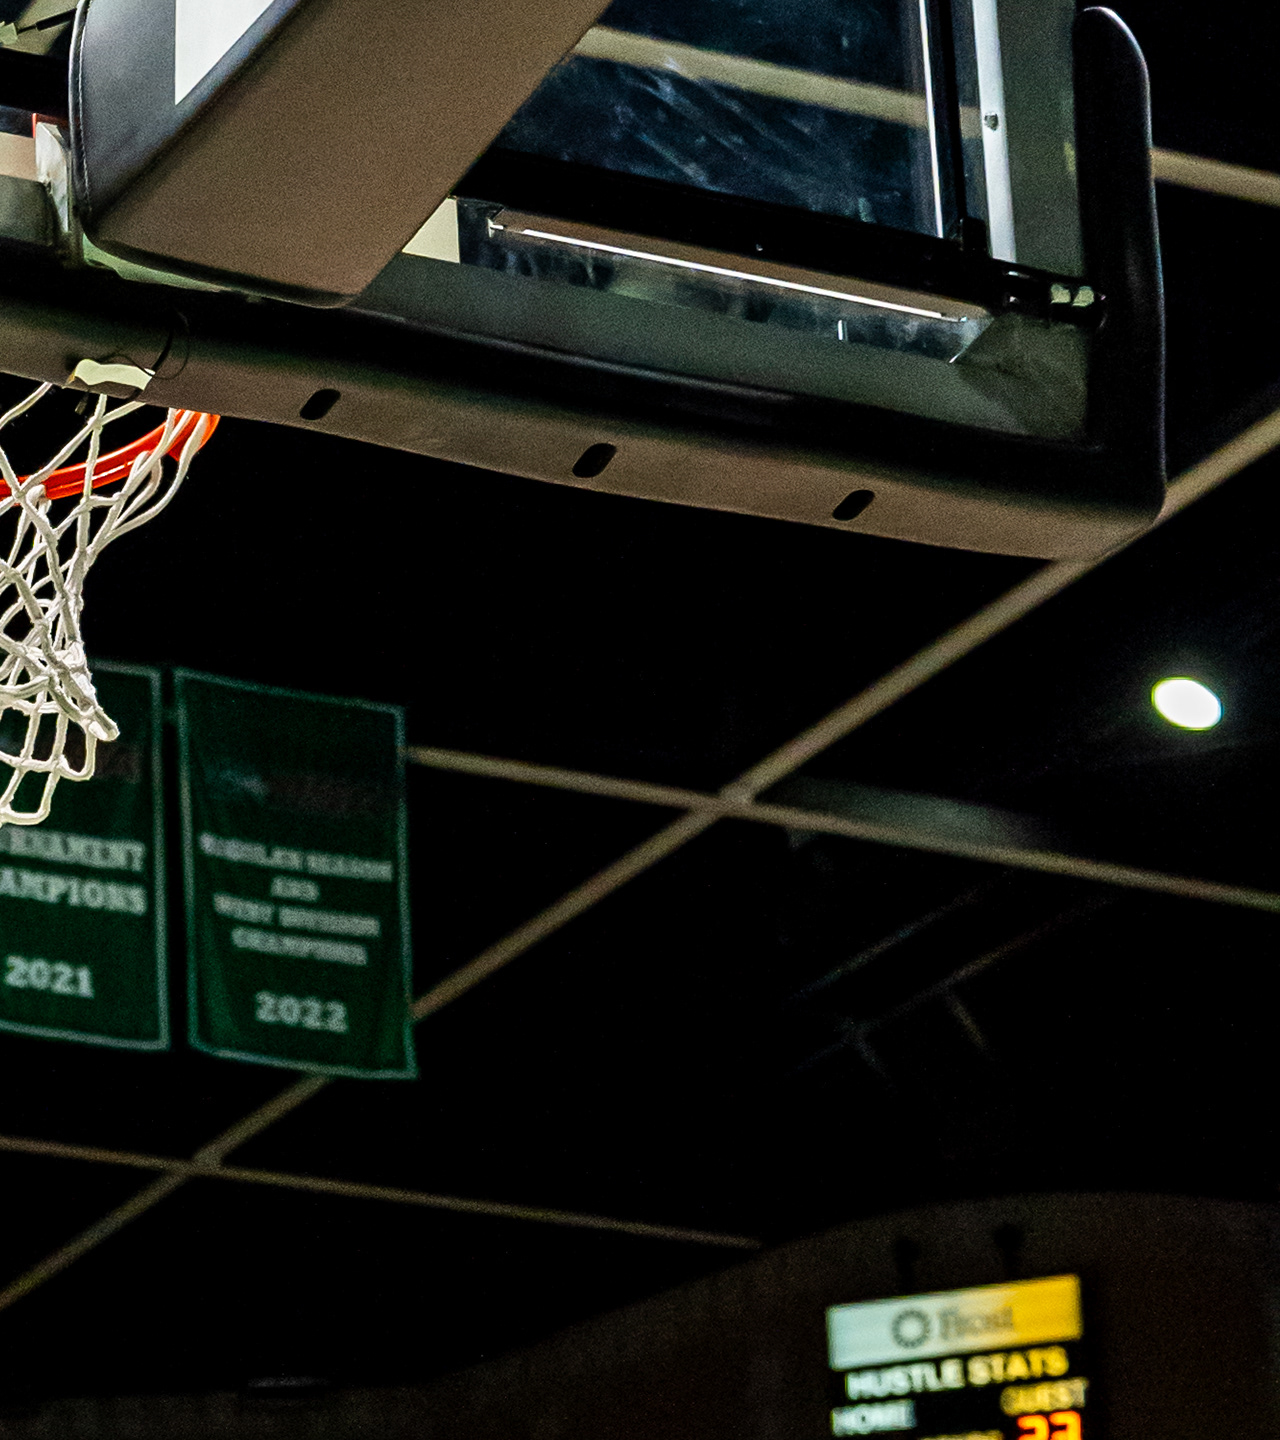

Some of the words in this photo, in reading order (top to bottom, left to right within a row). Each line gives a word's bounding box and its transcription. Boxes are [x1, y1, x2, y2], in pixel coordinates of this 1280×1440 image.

[3, 955, 95, 1000] 2021
[254, 989, 349, 1034] 2022
[844, 1357, 965, 1401] HUSTLE
[967, 1345, 1070, 1386] STATS
